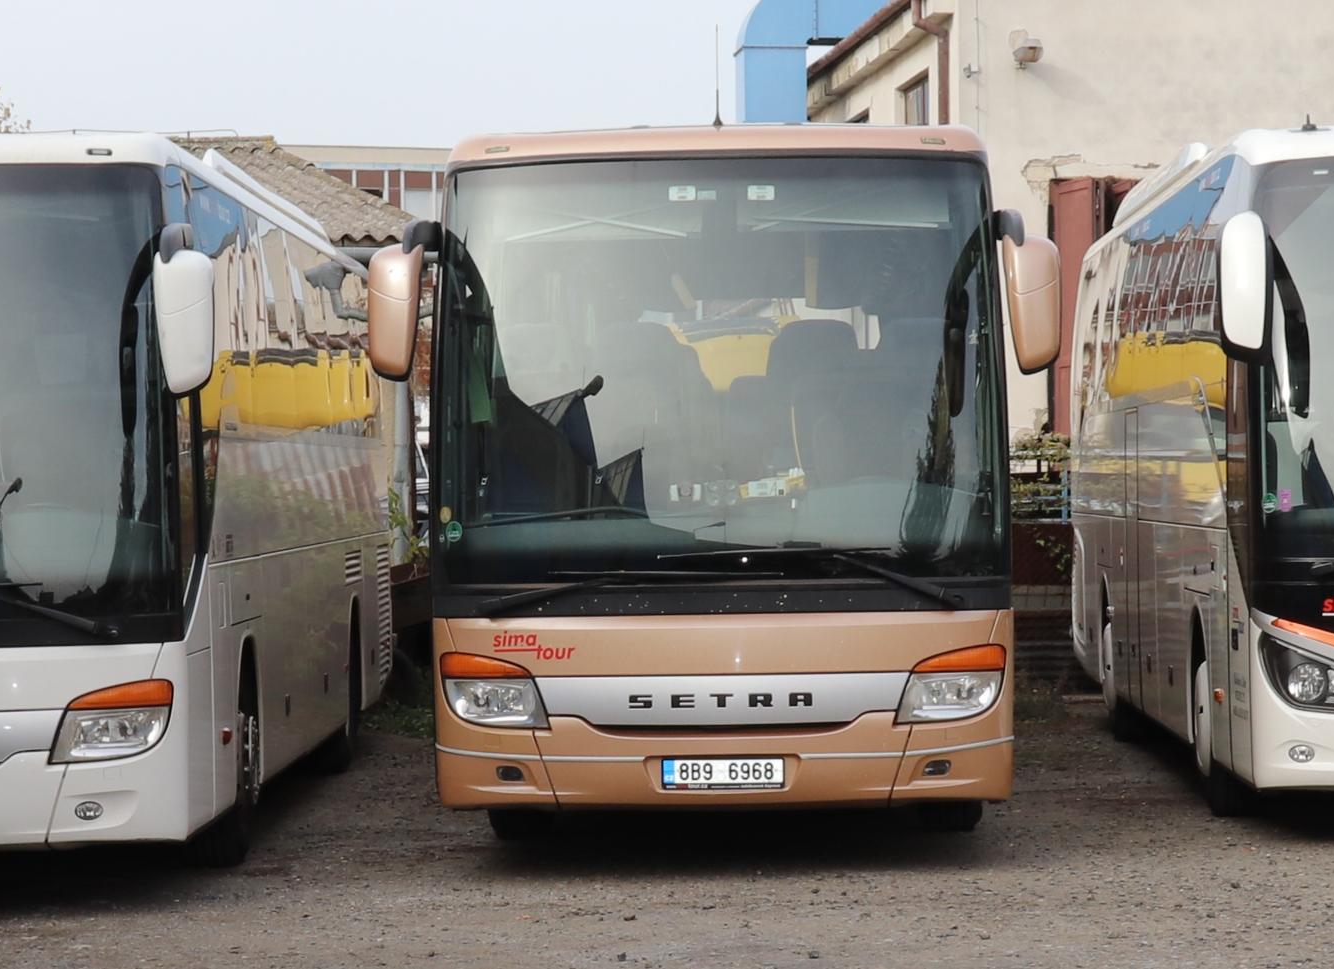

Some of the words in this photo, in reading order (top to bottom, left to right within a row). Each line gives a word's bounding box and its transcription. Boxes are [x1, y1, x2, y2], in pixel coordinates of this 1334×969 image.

[493, 631, 537, 647] sima
[536, 645, 575, 660] tour
[628, 692, 813, 709] SETRA
[679, 762, 713, 781] 8B9
[728, 762, 774, 780] 6968
